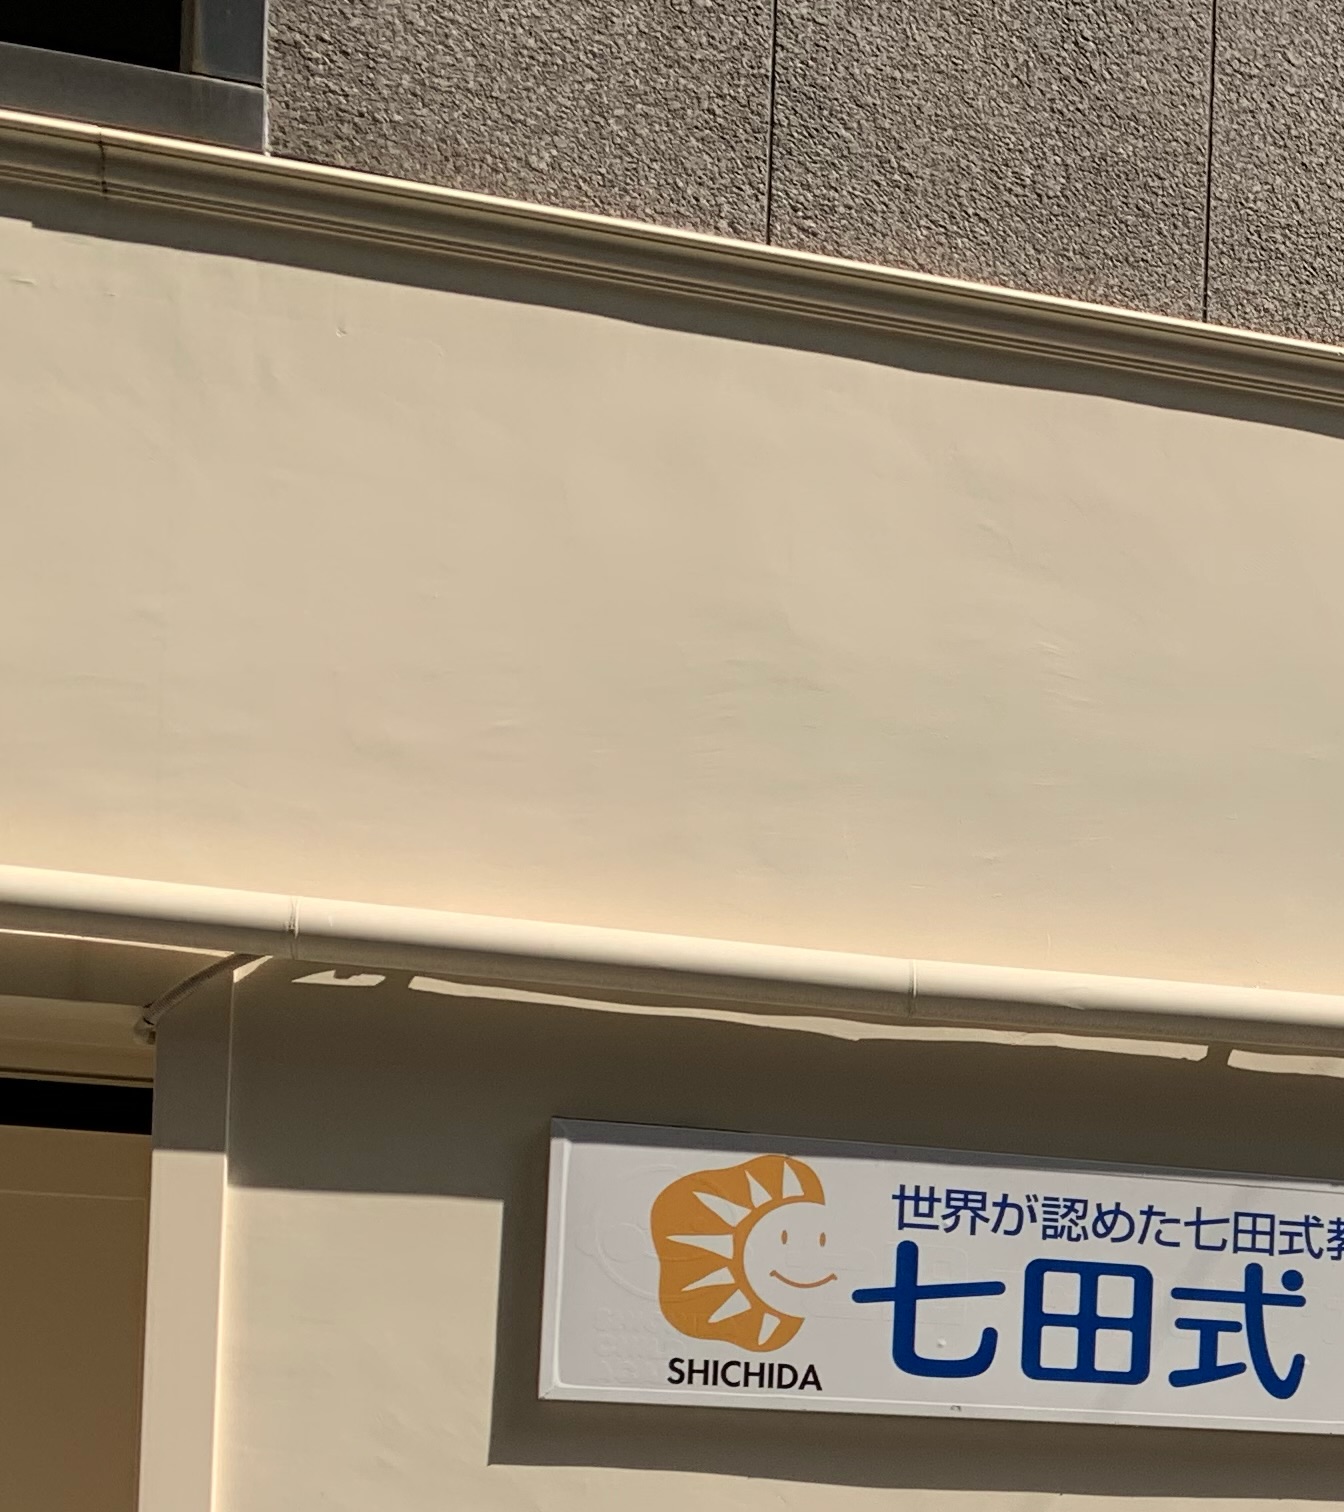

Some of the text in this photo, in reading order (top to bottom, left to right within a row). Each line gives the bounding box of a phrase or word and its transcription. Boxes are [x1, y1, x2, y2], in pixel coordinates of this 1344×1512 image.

[852, 1240, 1307, 1399] 七田式
[667, 1357, 823, 1391] SHICHIDA
